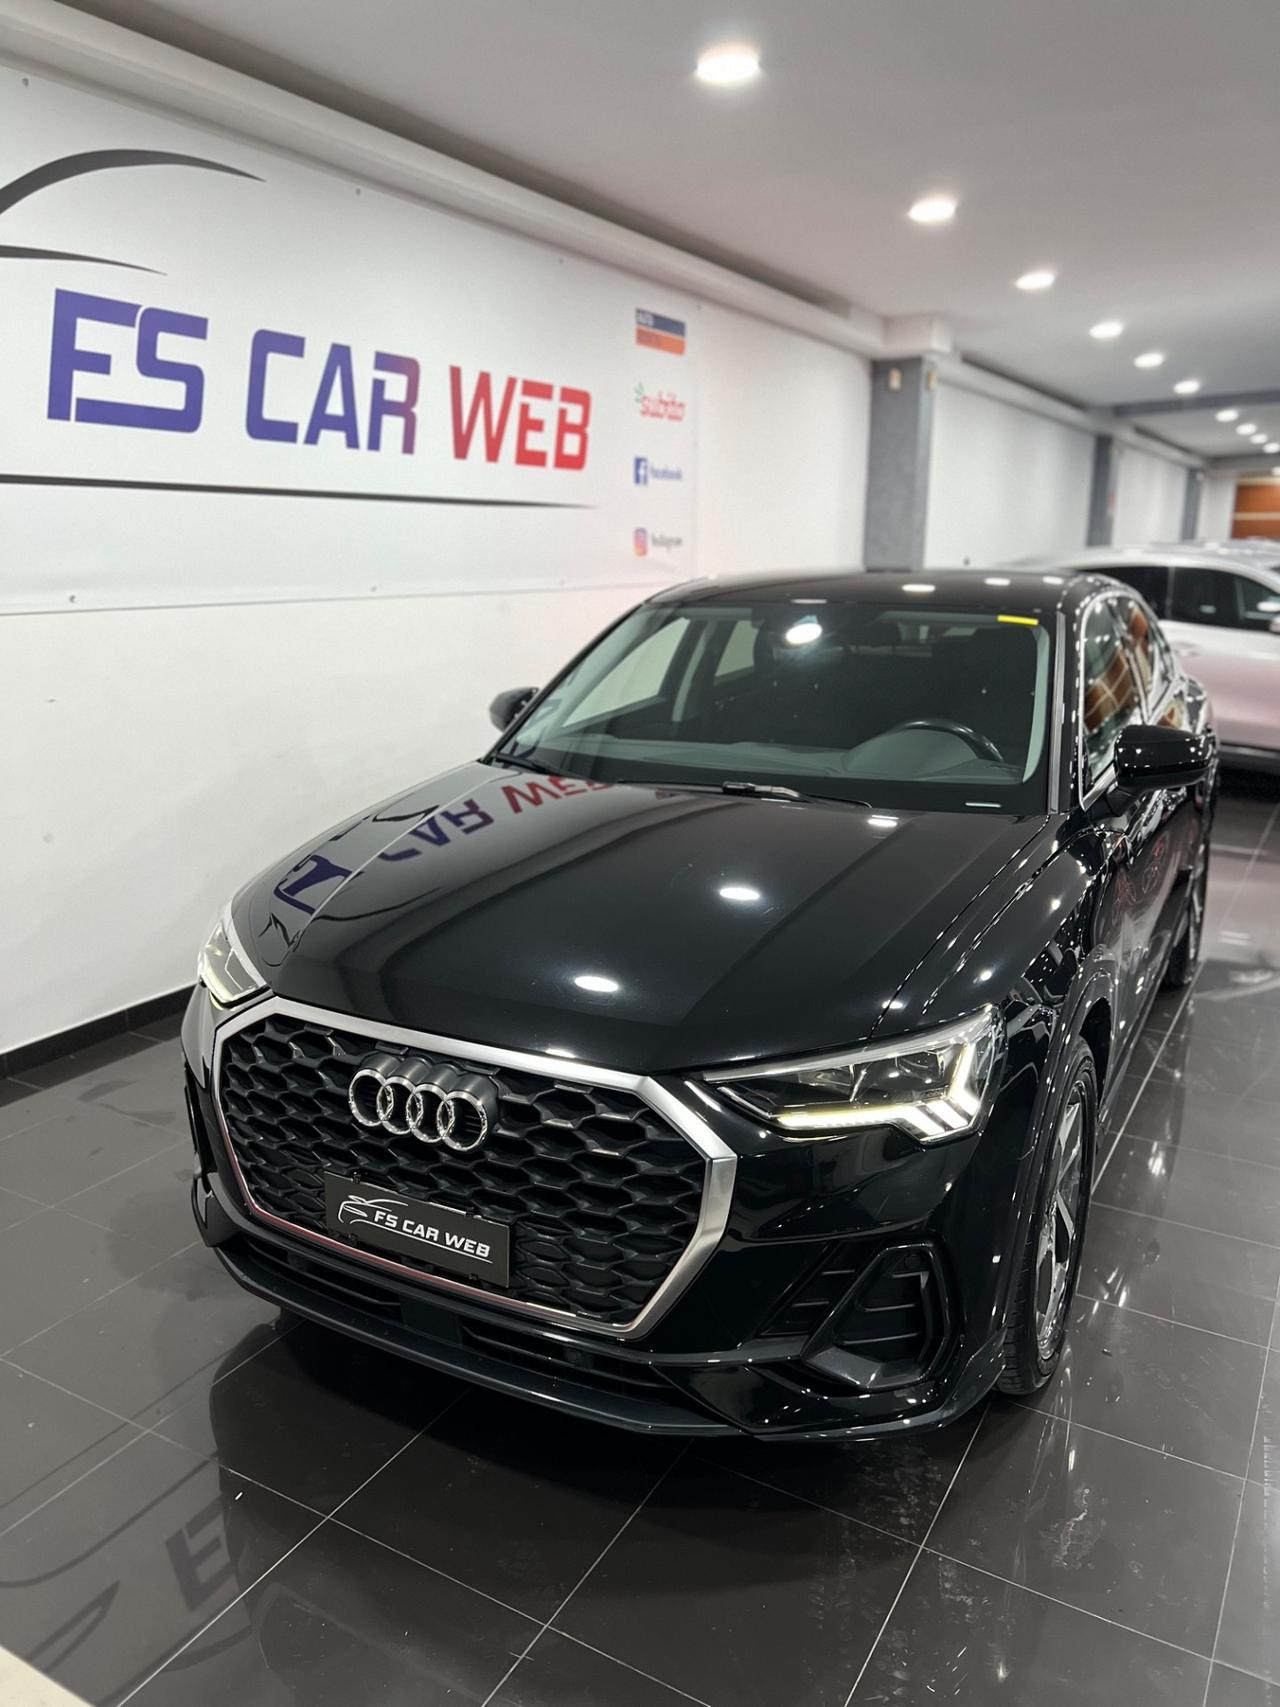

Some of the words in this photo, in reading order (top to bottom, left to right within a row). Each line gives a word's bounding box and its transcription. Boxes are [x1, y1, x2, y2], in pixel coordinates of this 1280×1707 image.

[246, 330, 419, 453] CAR
[449, 365, 592, 472] WEB
[374, 1210, 398, 1228] FS
[403, 1220, 439, 1241] CAR
[446, 1233, 490, 1257] WEB
